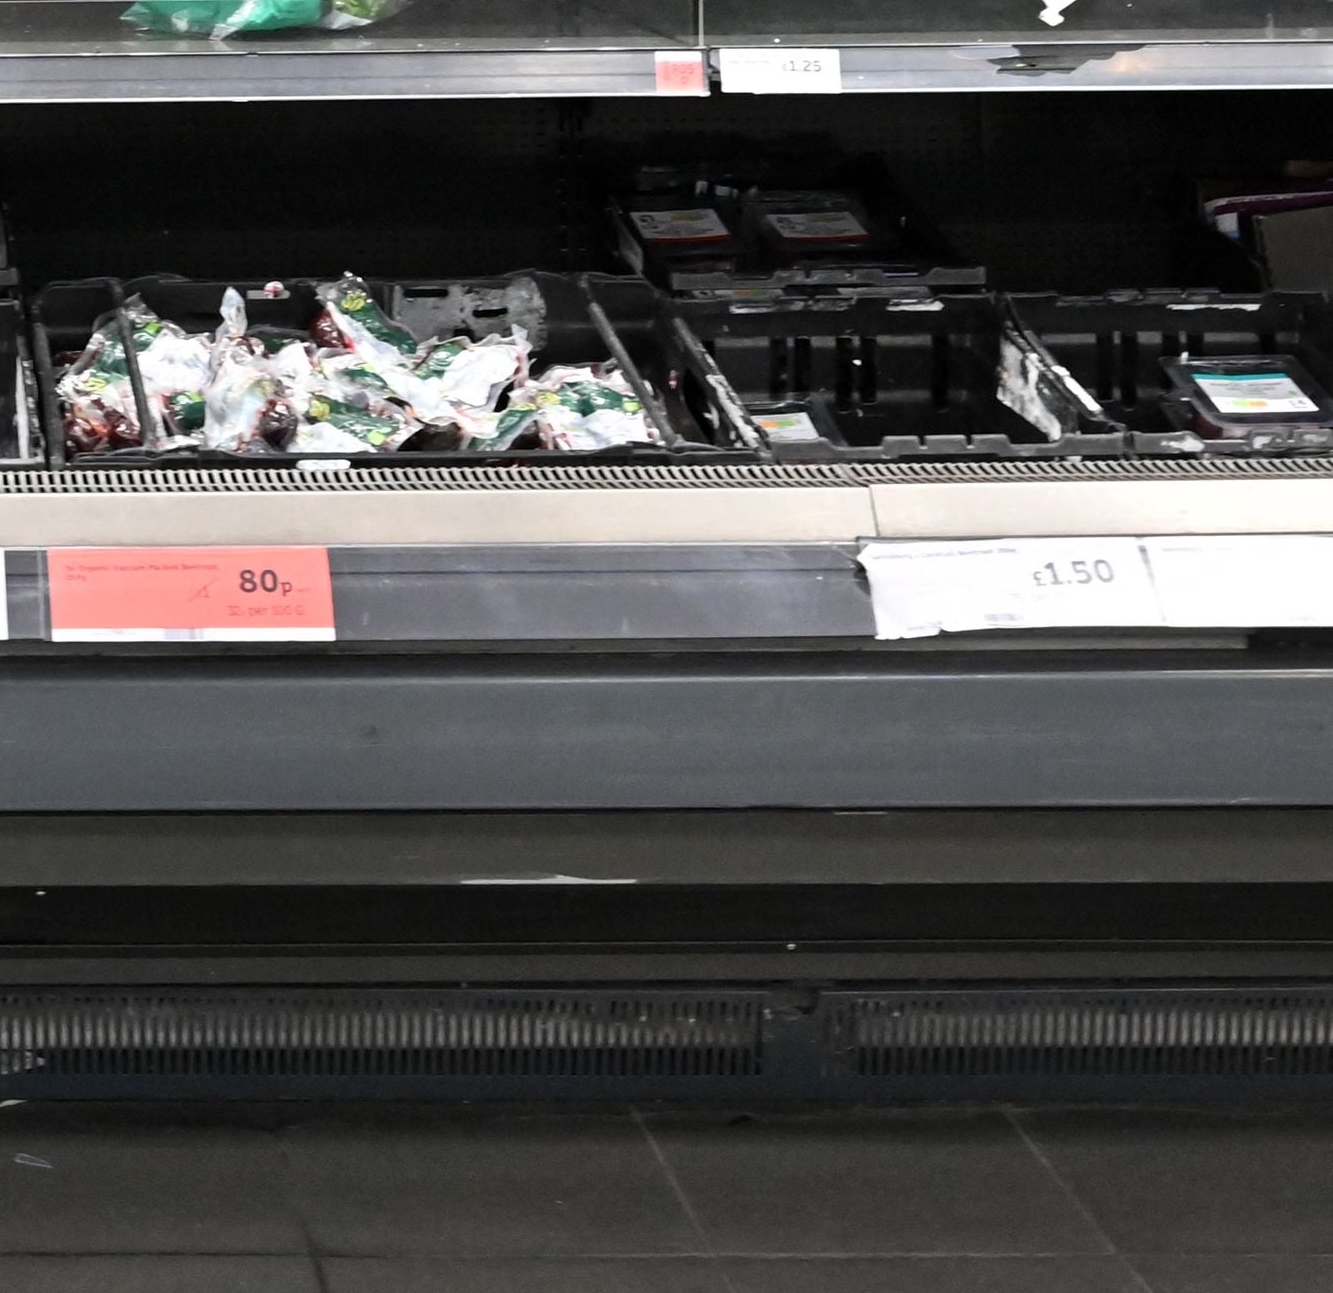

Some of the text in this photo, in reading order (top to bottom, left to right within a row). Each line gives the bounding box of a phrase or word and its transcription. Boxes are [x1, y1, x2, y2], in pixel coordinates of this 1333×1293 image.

[782, 60, 822, 73] £125
[239, 569, 293, 597] 80p
[1032, 558, 1116, 588] £1.50
